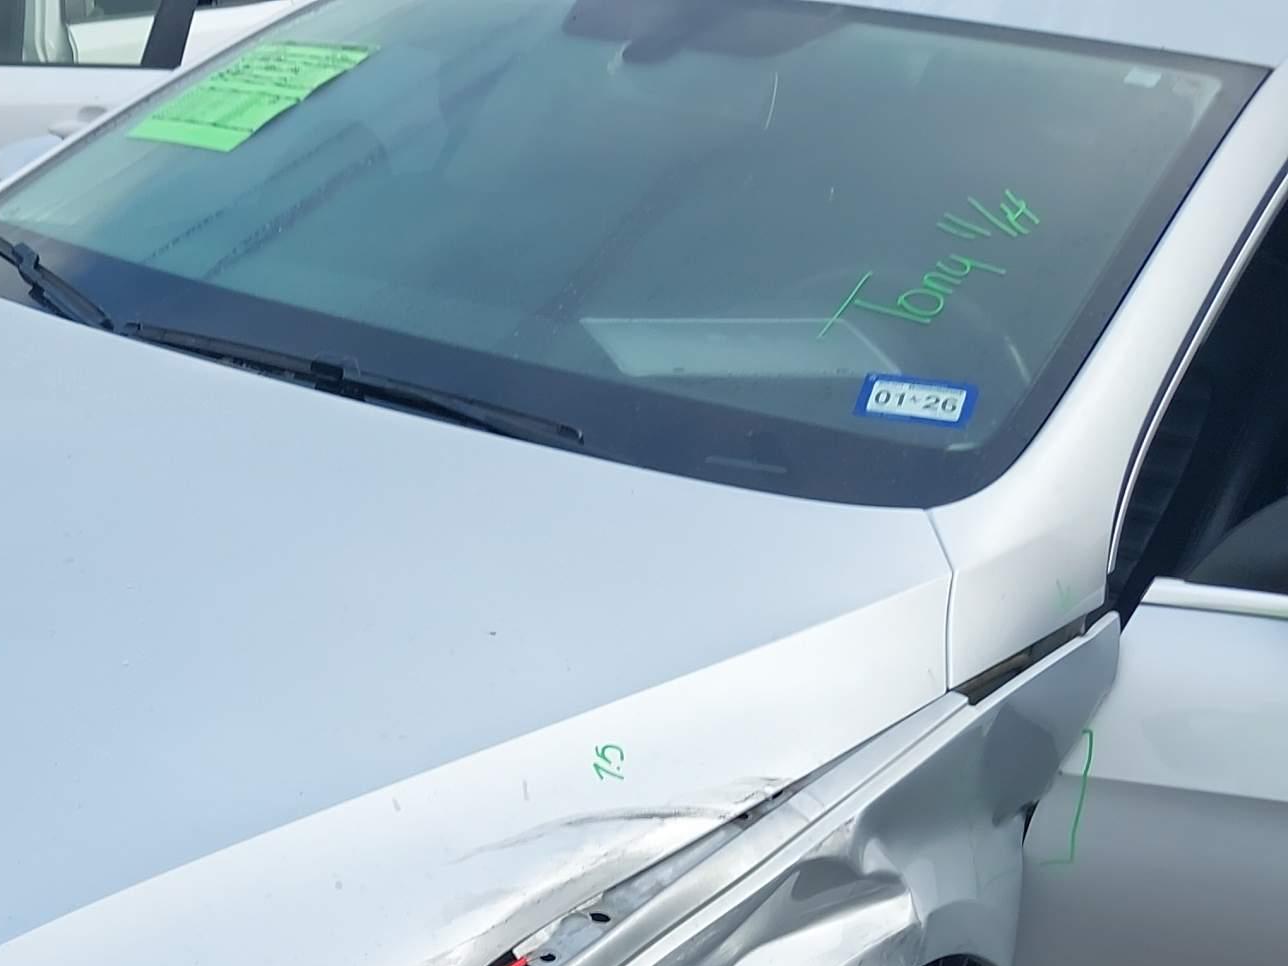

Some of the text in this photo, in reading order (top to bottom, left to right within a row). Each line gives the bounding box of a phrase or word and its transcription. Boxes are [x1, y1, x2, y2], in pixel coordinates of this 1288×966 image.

[816, 252, 1007, 340] Tony
[874, 389, 958, 413] 01 26
